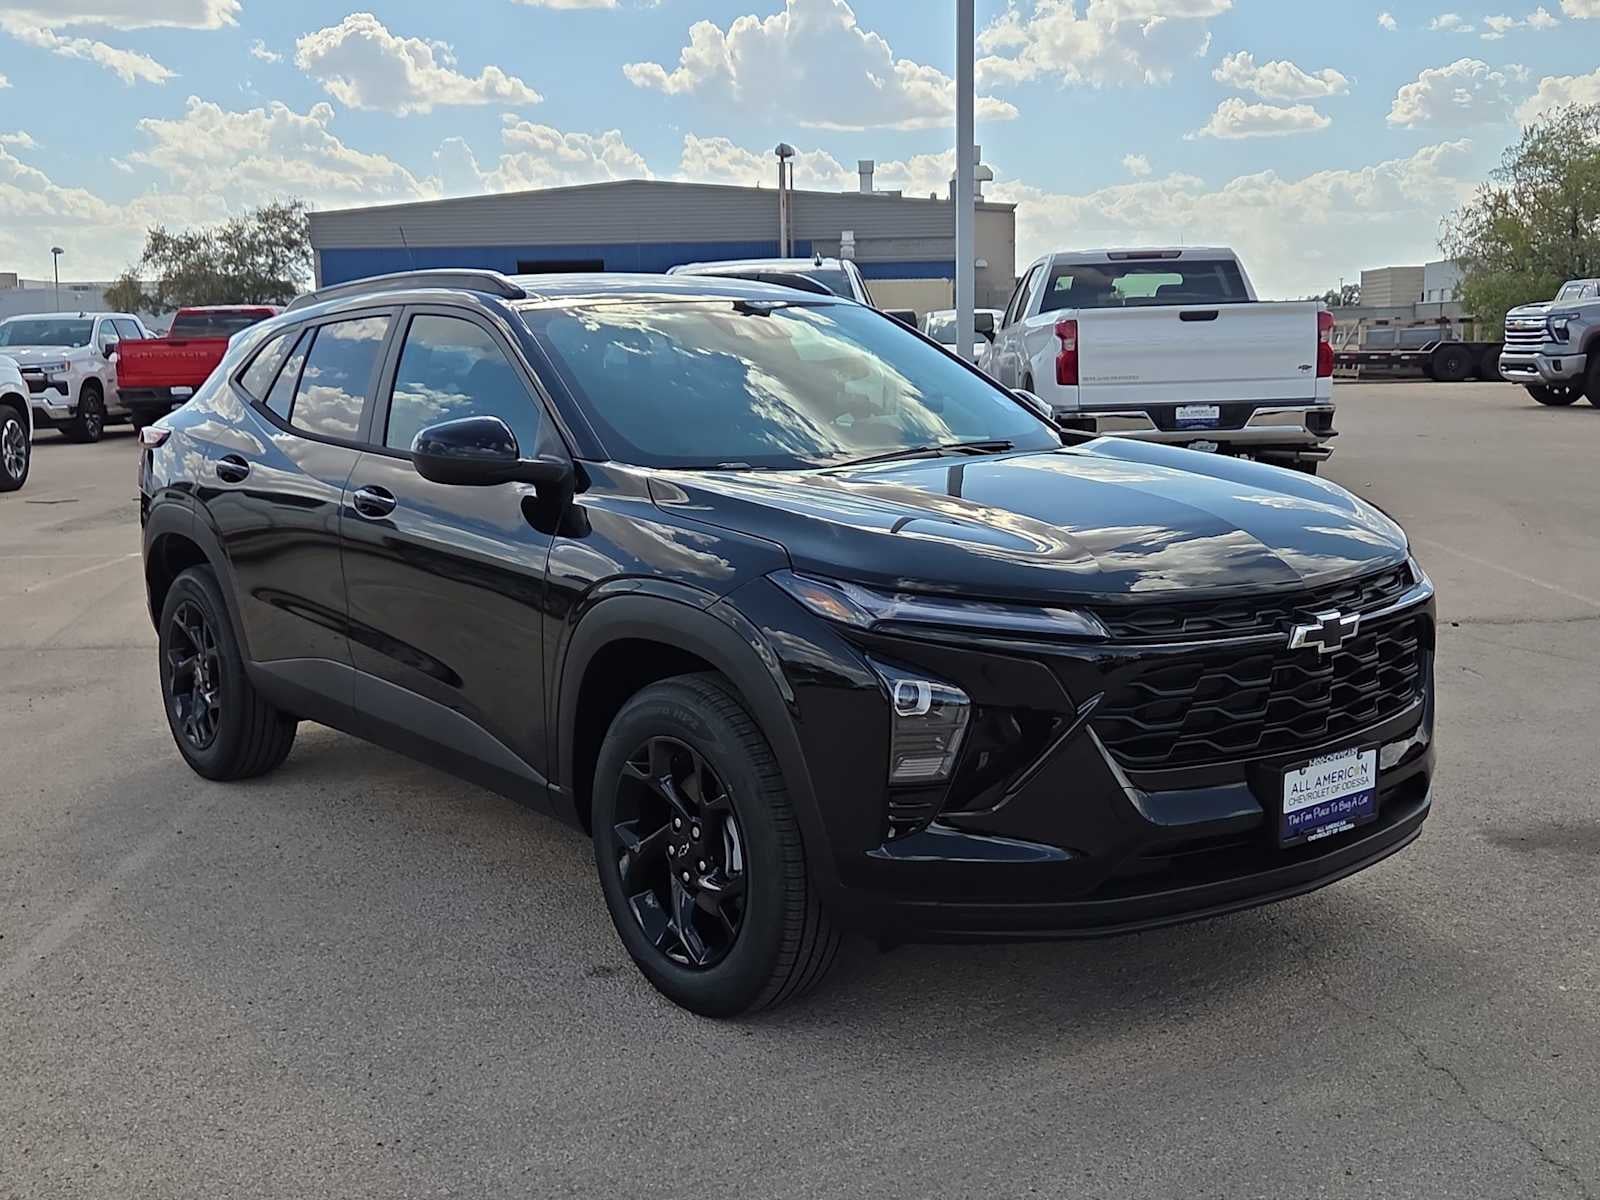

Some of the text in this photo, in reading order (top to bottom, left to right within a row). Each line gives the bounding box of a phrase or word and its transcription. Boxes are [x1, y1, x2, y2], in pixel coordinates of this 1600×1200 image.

[1288, 776, 1369, 806] CHEVROLET OF ODESSA
[1291, 780, 1311, 796] ALL
